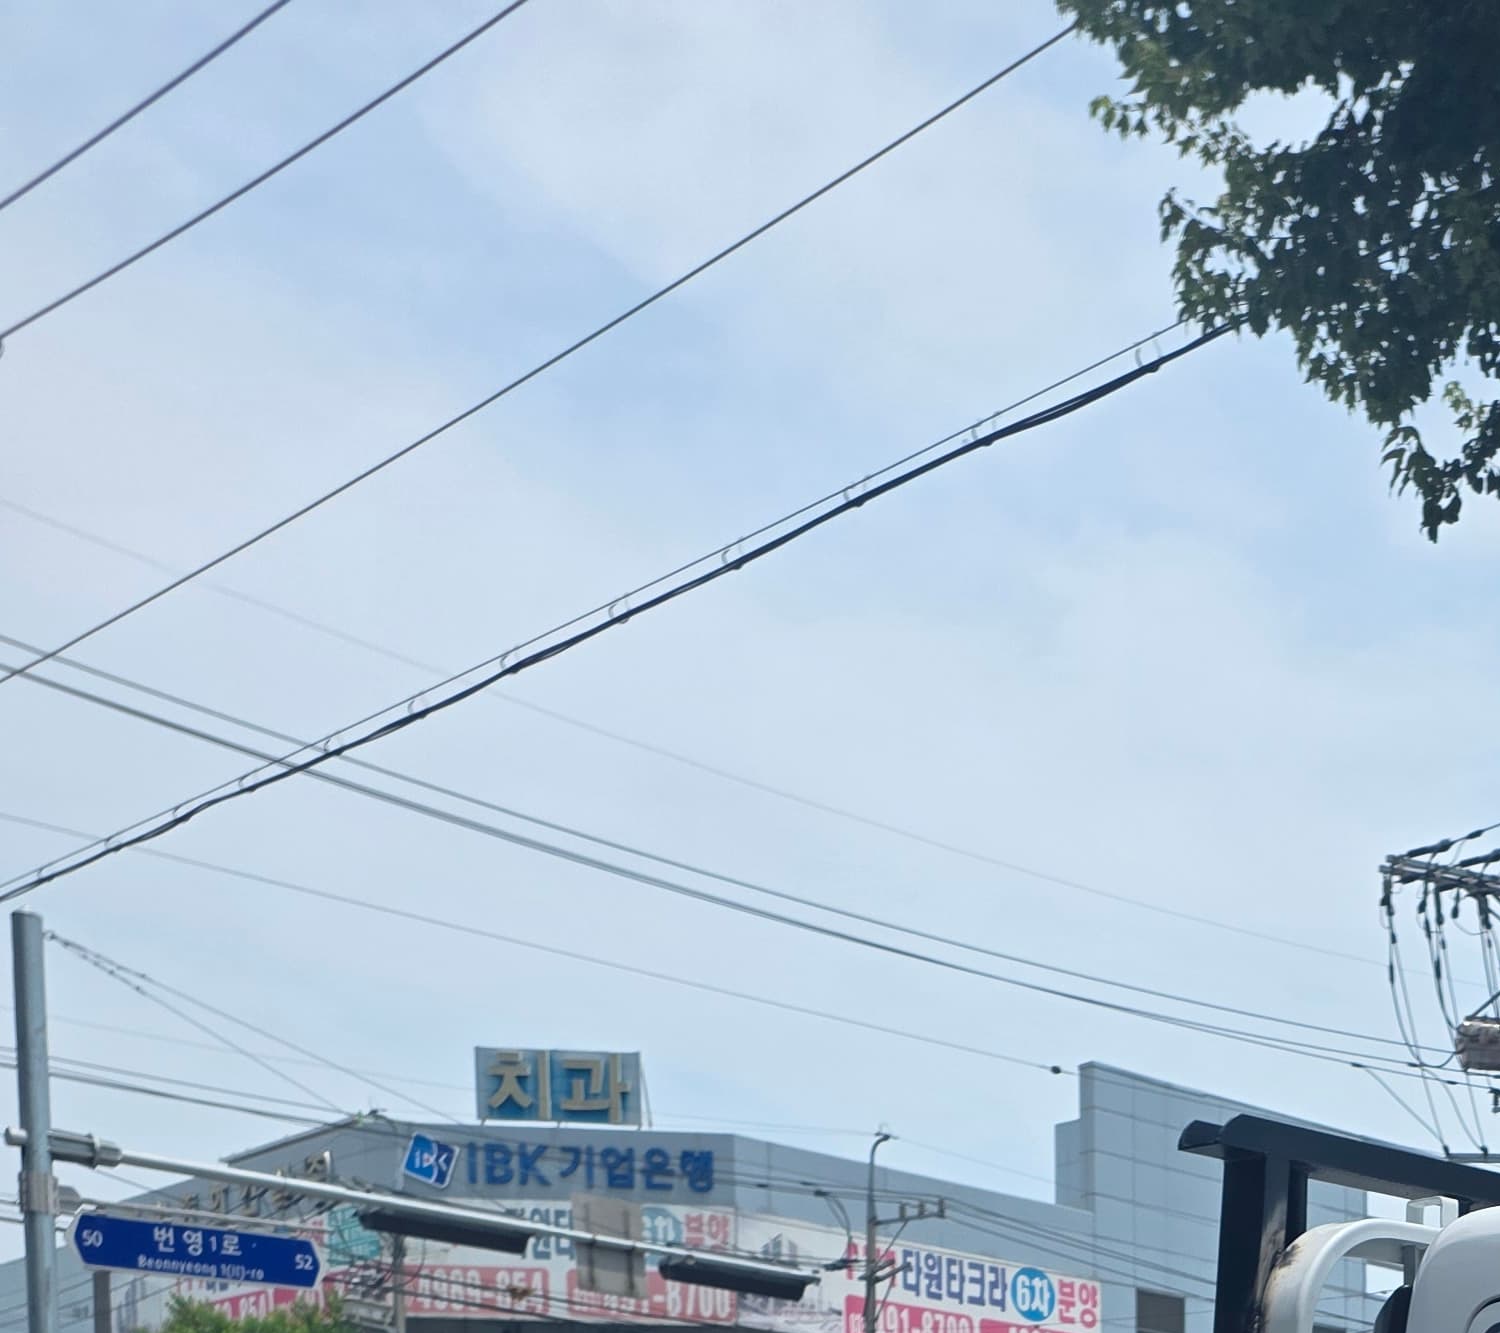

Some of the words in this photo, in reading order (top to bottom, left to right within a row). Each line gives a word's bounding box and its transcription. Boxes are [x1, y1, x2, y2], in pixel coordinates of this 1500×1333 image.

[487, 1052, 631, 1124] 치과
[466, 1142, 551, 1186] IBK
[559, 1146, 714, 1192] 기업은행
[82, 1228, 104, 1248] 50
[153, 1226, 242, 1256] 번영1로
[294, 1253, 314, 1270] 52
[1016, 1272, 1051, 1316] 6차
[1059, 1280, 1098, 1329] 분양
